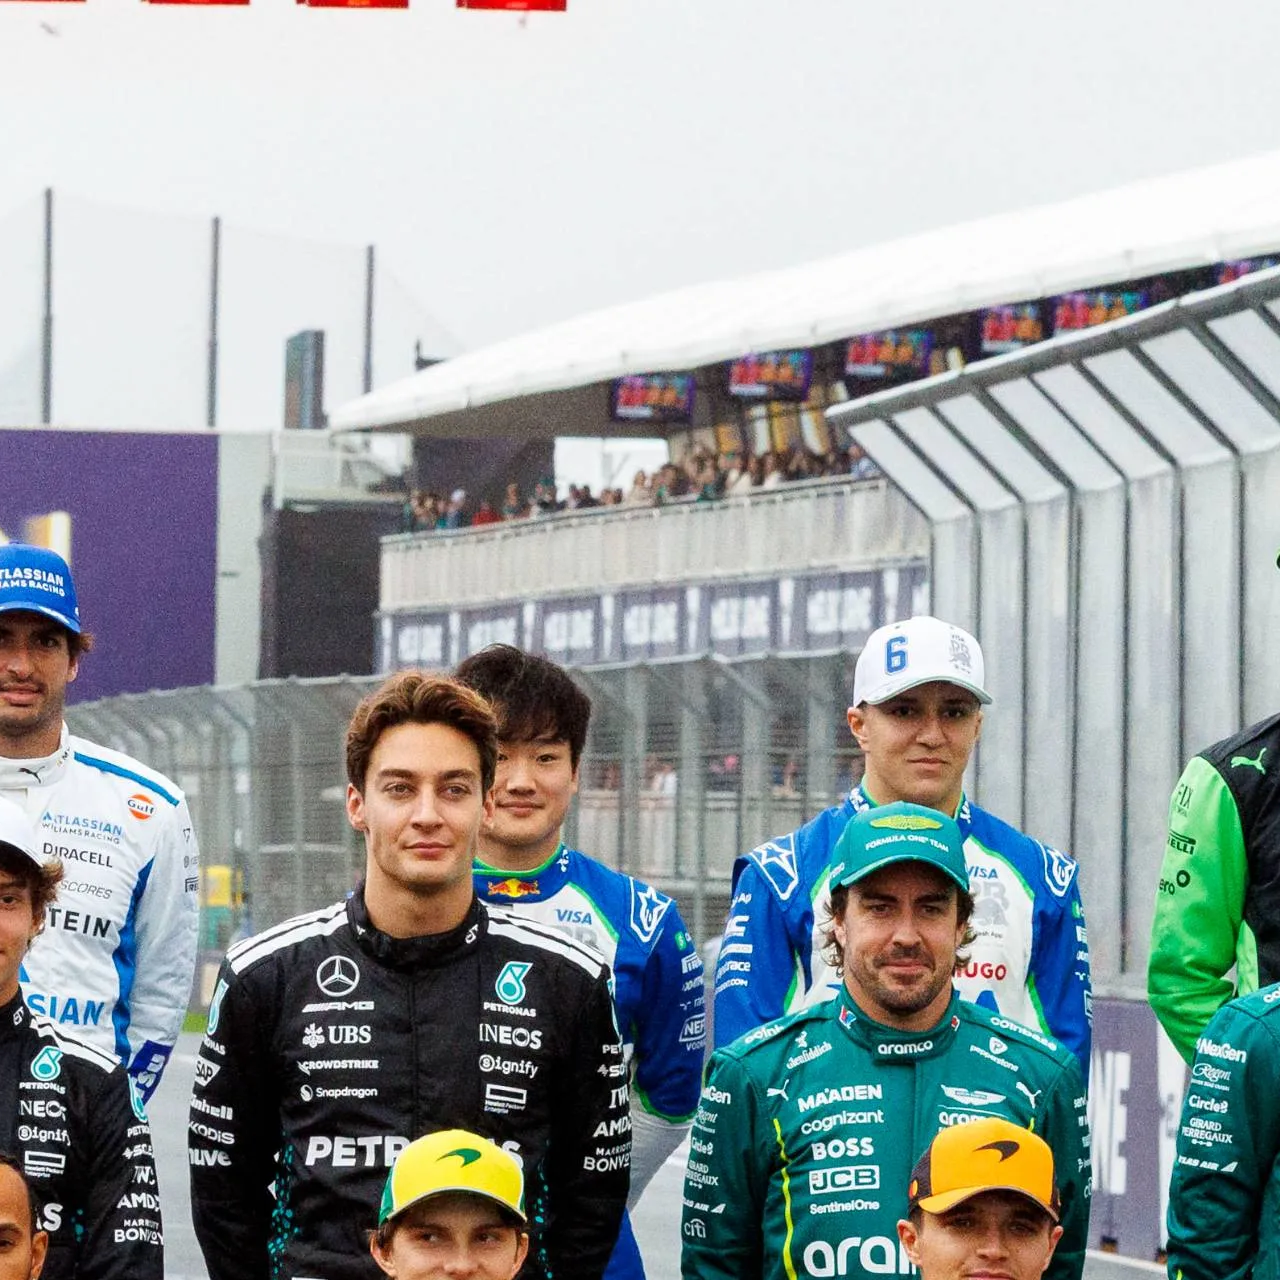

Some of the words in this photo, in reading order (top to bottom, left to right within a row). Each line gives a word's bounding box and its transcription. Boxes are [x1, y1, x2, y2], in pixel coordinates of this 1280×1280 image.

[885, 637, 908, 675] 6
[128, 800, 155, 813] Gulf
[865, 835, 906, 851] FORMULA
[929, 839, 949, 853] TEAM
[556, 909, 592, 925] VISA
[483, 1002, 536, 1017] PETRONAS
[328, 1025, 372, 1044] UBS
[479, 1023, 541, 1049] INEOS
[877, 1039, 934, 1055] aramco
[1199, 1038, 1246, 1063] NexGen
[303, 1059, 379, 1071] CROWDSTRIKE
[970, 1045, 1019, 1072] pepperstone
[315, 1086, 378, 1098] Snapdragon
[801, 1110, 884, 1135] cognizant
[1190, 1117, 1222, 1131] GIRARD
[813, 1138, 874, 1161] BOSS
[812, 1169, 877, 1190] JCB
[810, 1199, 880, 1215] SentinelOne
[684, 1219, 706, 1239] citi
